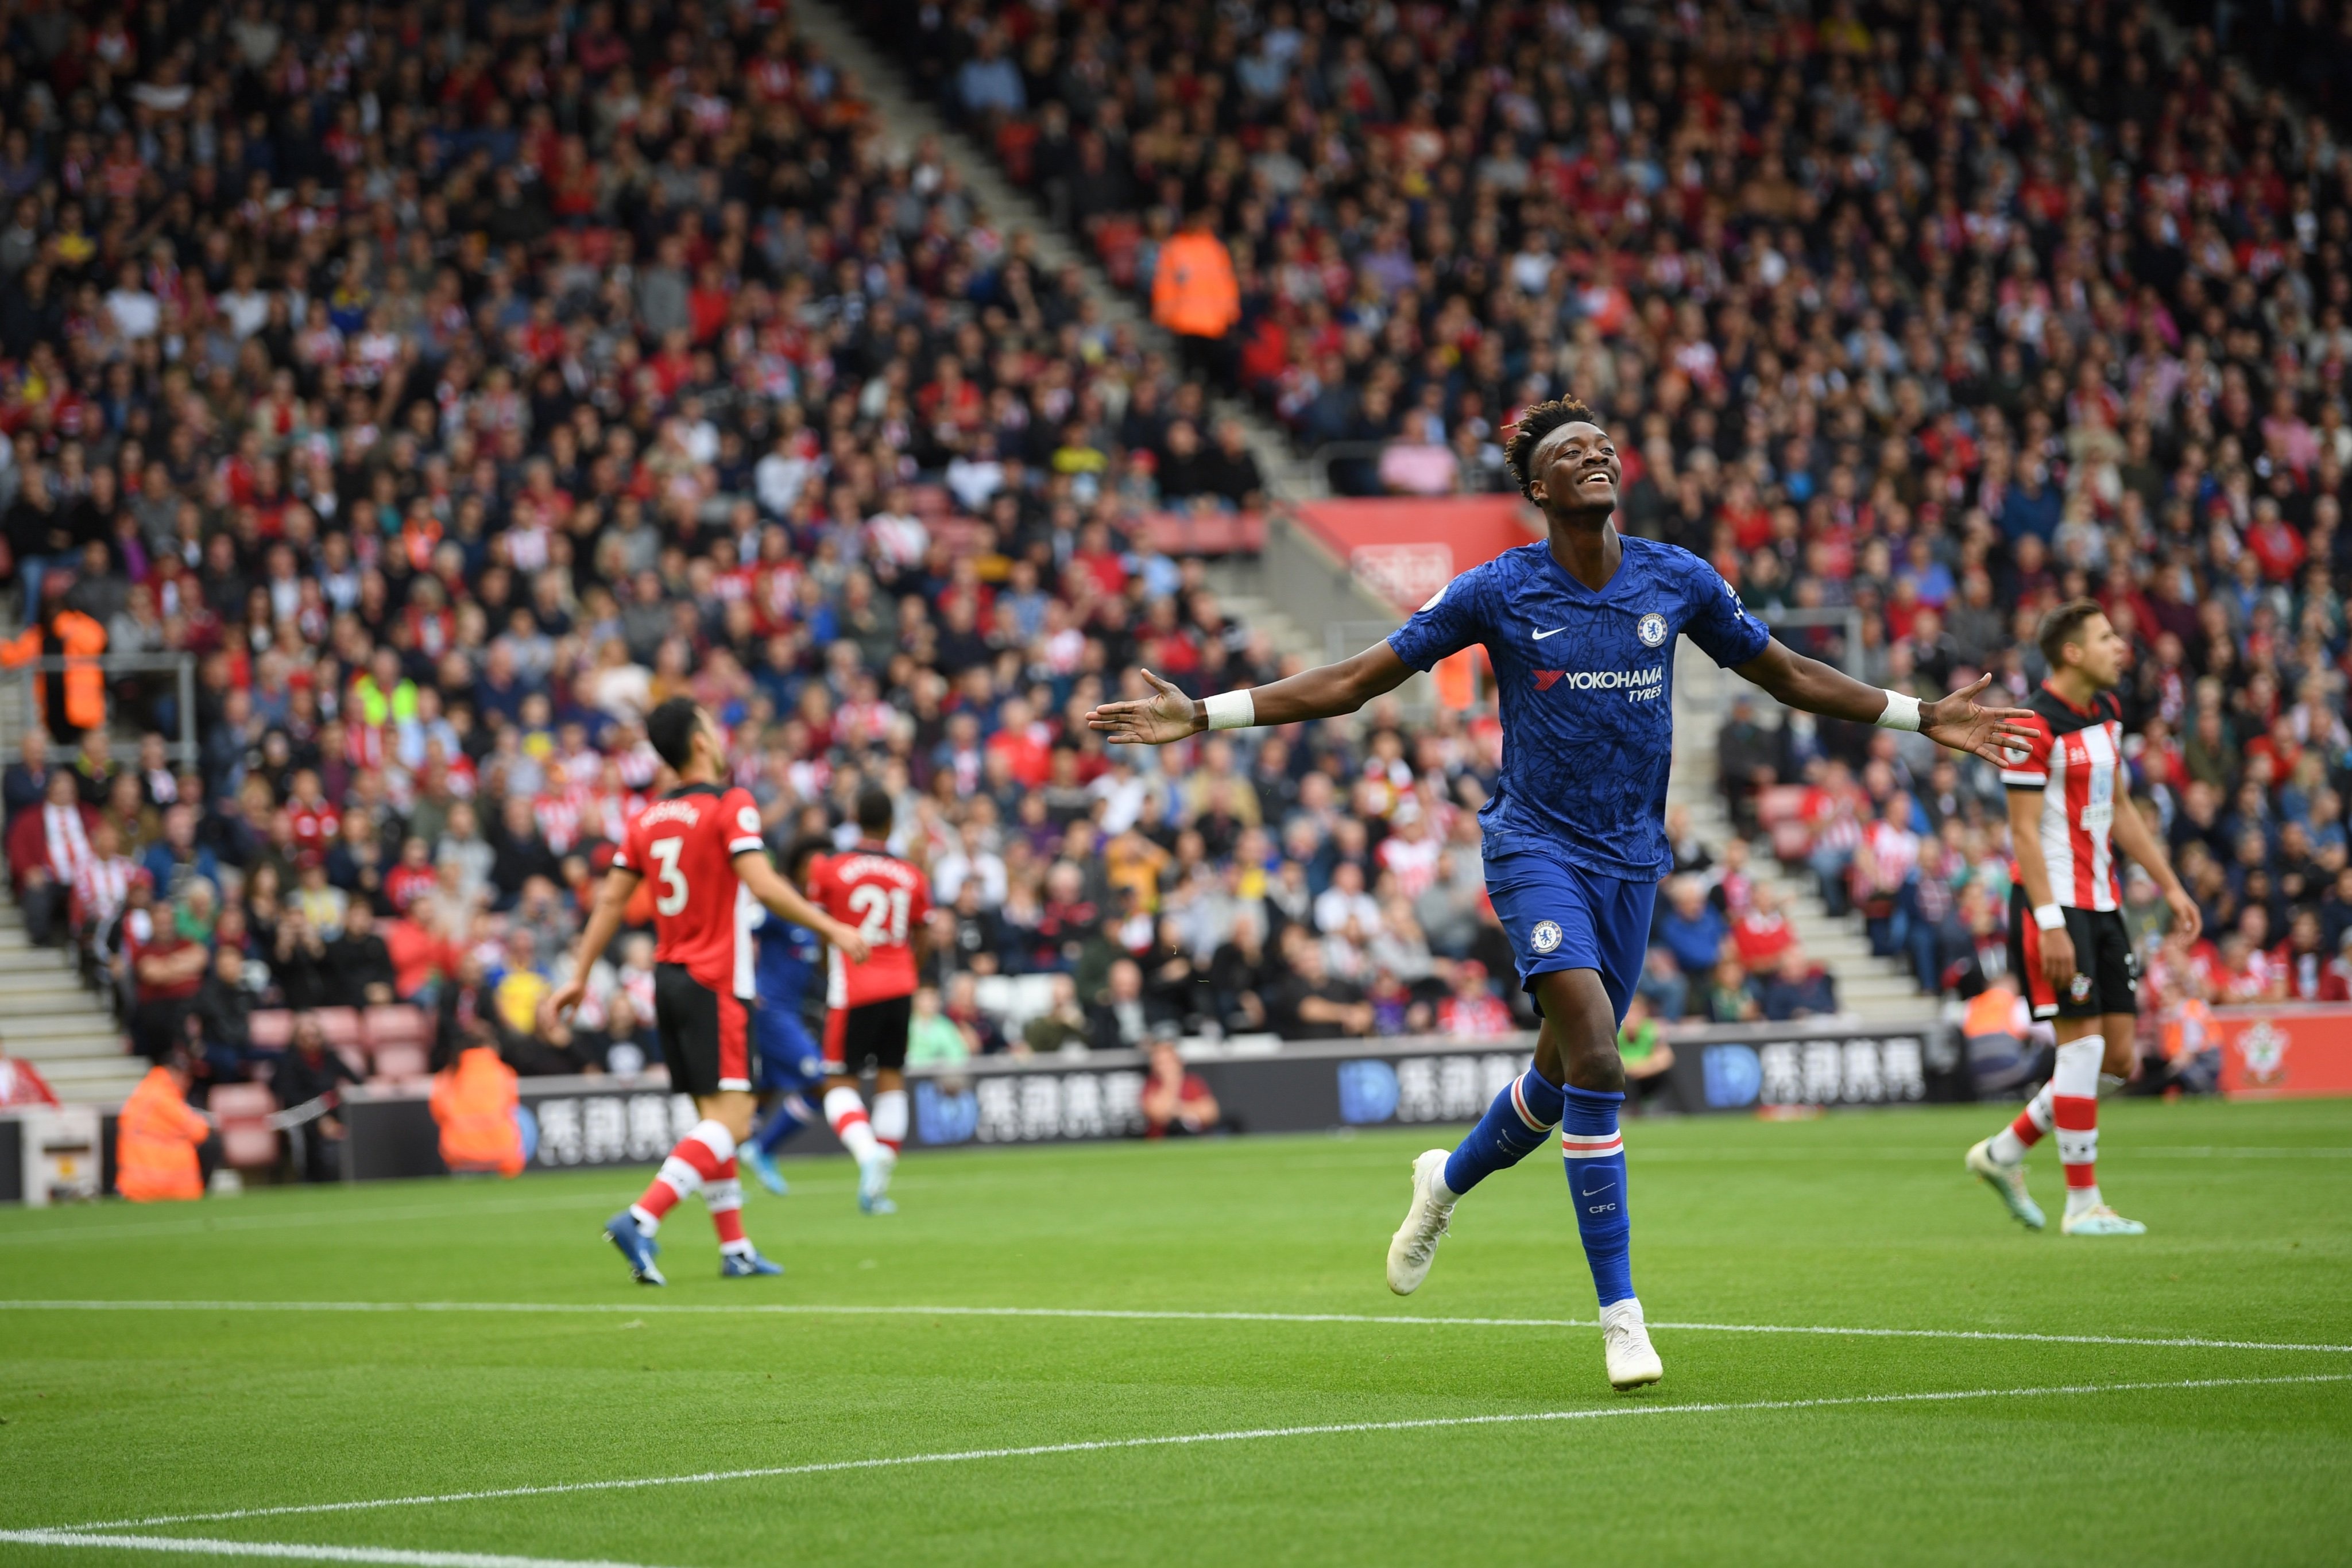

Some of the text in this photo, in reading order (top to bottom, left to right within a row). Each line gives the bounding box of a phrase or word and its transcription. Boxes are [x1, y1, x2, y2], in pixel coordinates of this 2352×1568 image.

[1565, 665, 1662, 690] YOKOHAMA
[1628, 684, 1662, 703] TYRES
[649, 835, 688, 917] 3
[848, 883, 912, 946] 21
[1533, 922, 1553, 934] CHELSEA
[1589, 1203, 1616, 1214] CFC
